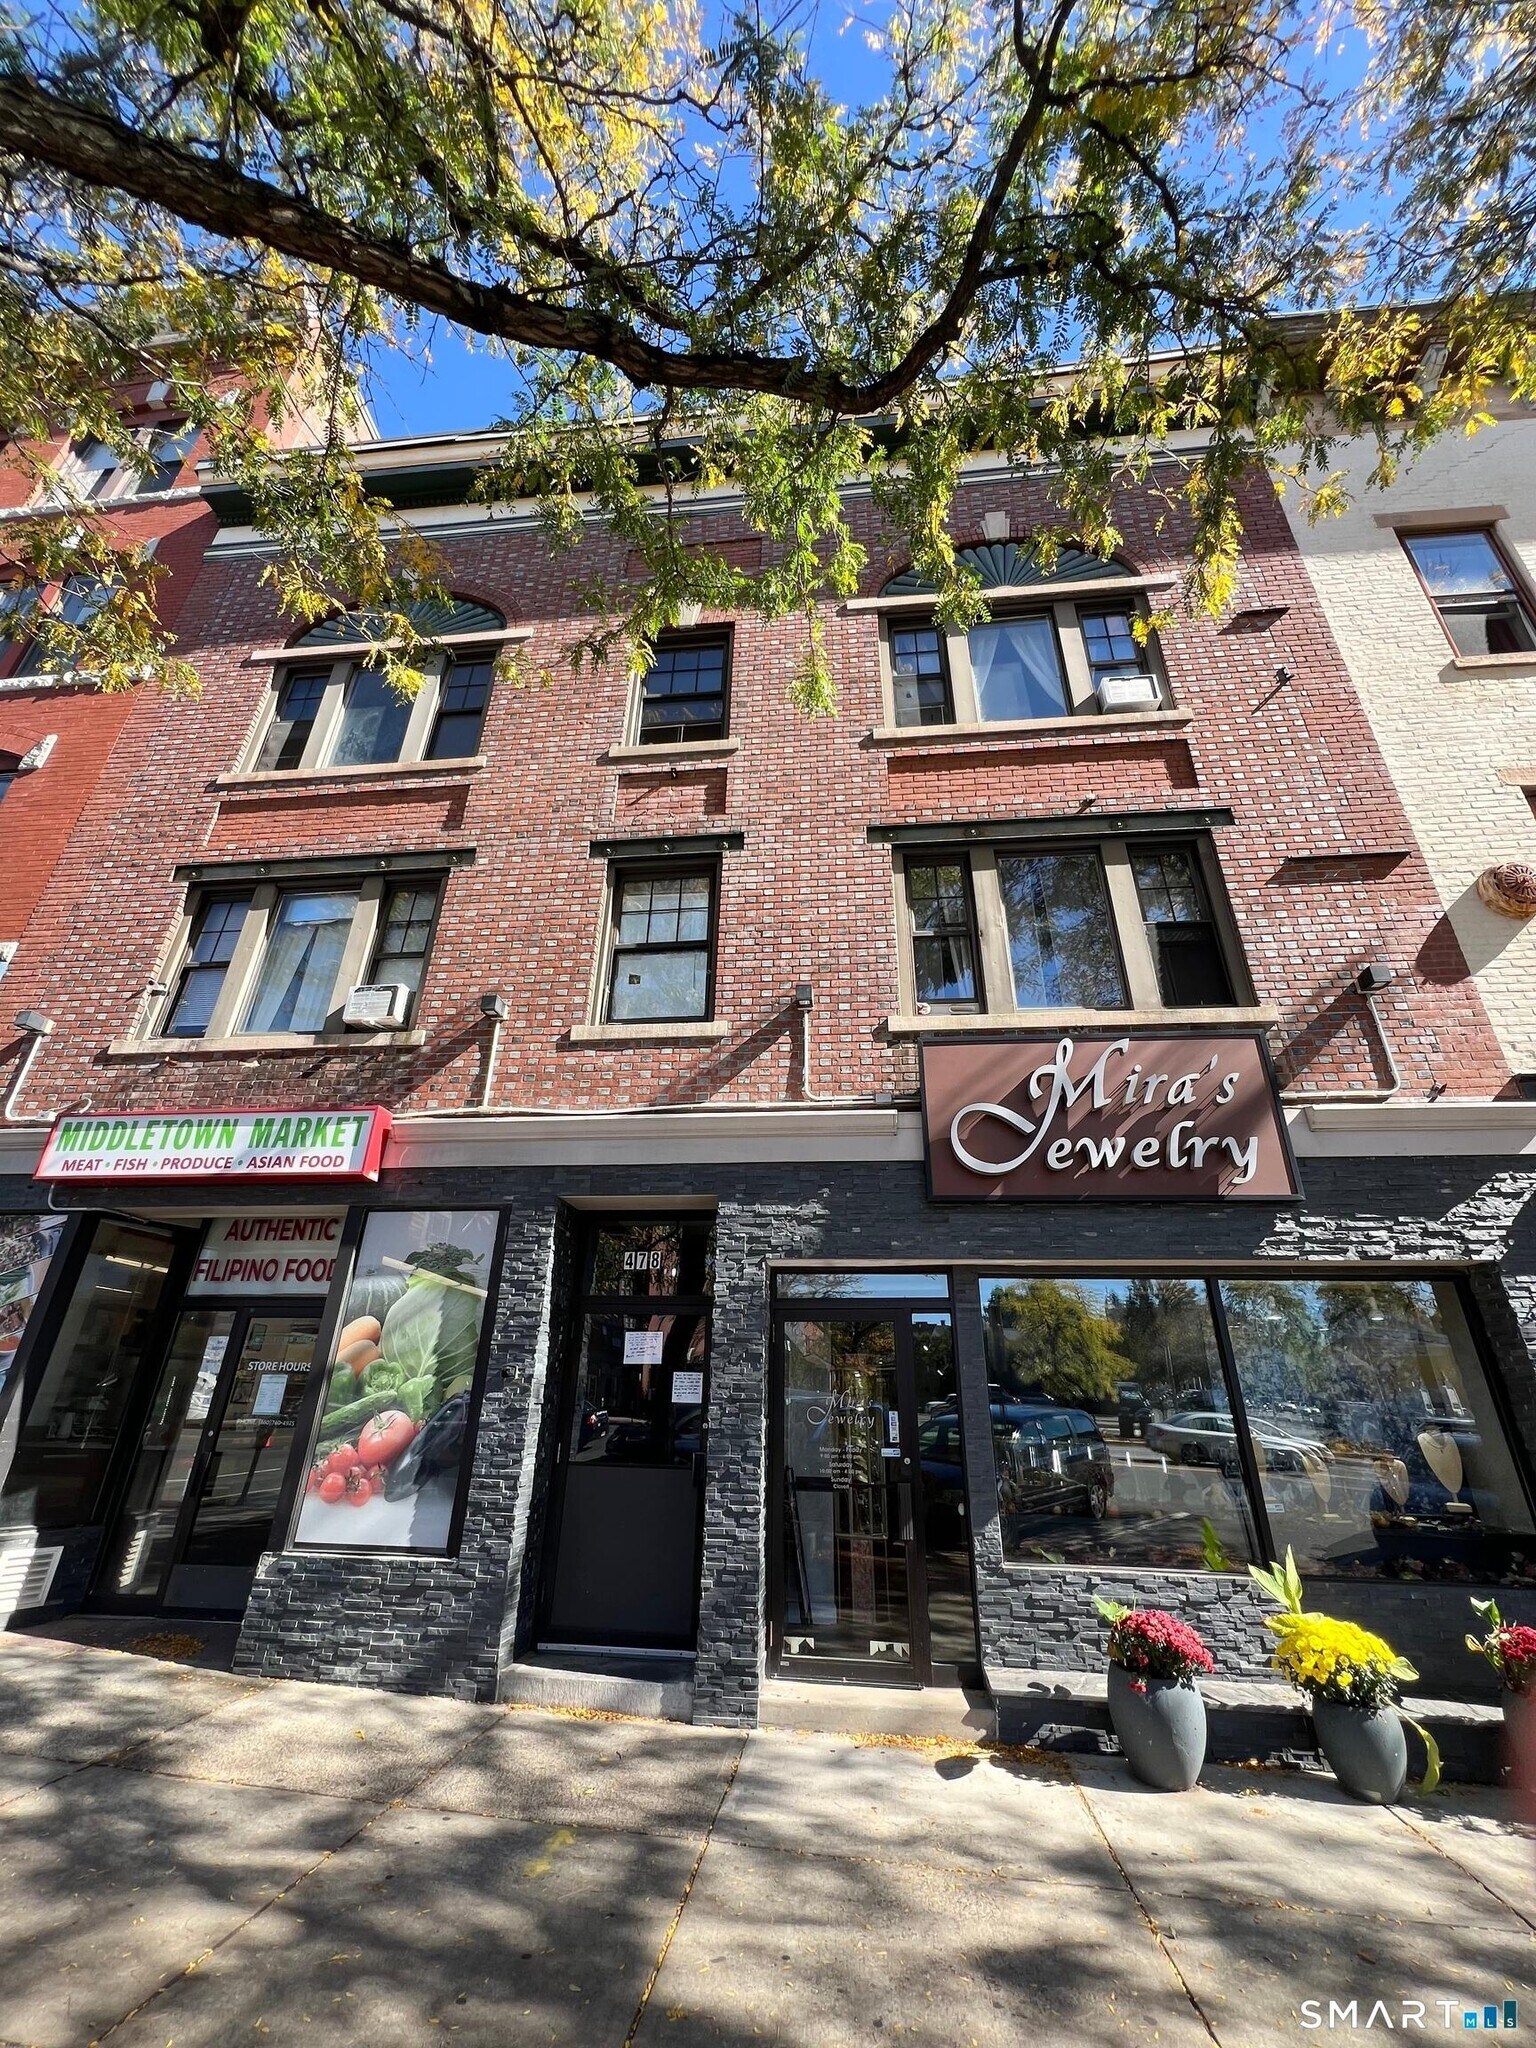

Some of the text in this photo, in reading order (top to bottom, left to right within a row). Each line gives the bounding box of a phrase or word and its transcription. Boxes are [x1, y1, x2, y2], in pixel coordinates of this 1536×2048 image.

[1029, 1037, 1240, 1111] Mira's
[55, 1115, 370, 1152] MIDDLETOWN MARKET
[950, 1101, 1258, 1185] Jewelry
[60, 1155, 344, 1172] MEAT FISH PRODUCE ASIAN FOOD
[223, 1217, 340, 1242] AUTHENTIC
[192, 1258, 280, 1283] FILIPINO
[624, 1251, 661, 1269] 478
[247, 1360, 279, 1371] STORE
